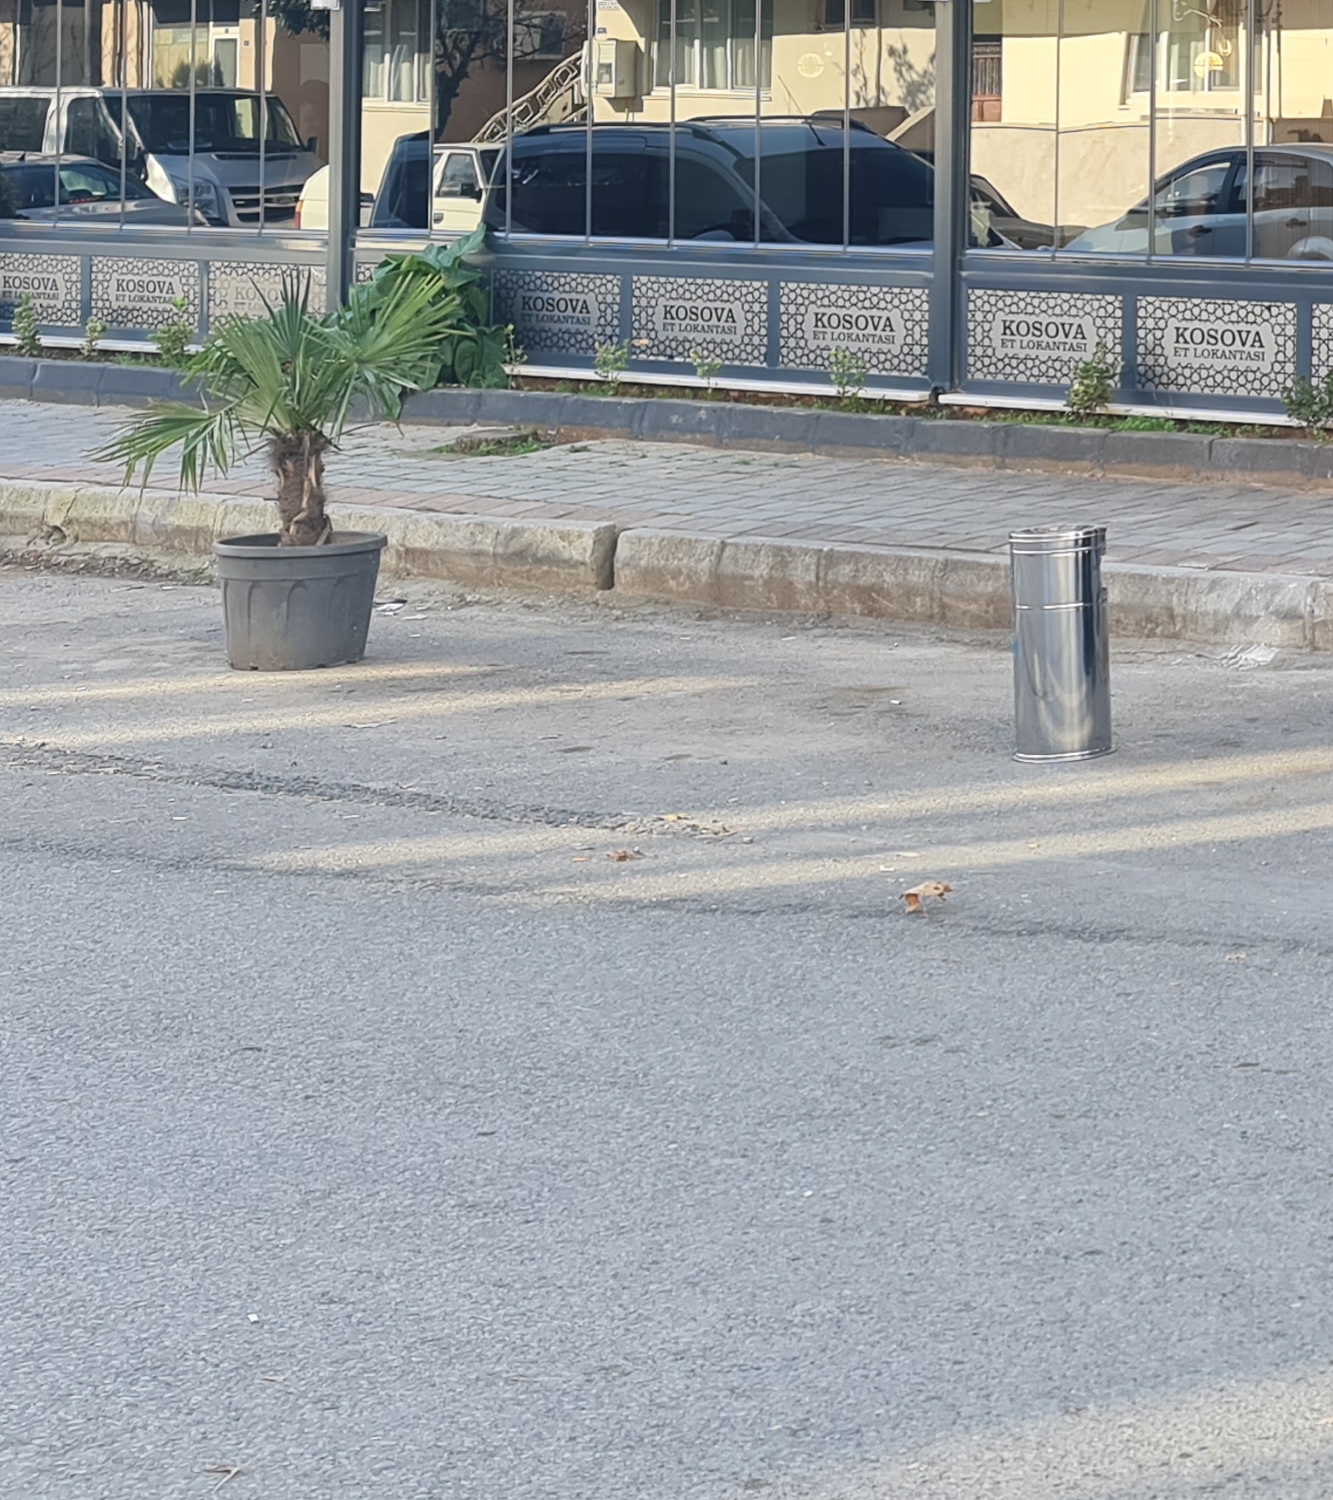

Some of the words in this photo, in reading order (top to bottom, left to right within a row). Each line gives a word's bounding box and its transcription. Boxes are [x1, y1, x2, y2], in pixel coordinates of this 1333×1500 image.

[3, 275, 59, 291] KOSOVA
[116, 278, 176, 294] KOSOVA
[520, 295, 591, 315] KOSOVA
[520, 312, 537, 322] ET
[539, 314, 592, 327] LOKANTASI
[662, 303, 738, 324] KOSOVA
[662, 323, 678, 333] ET
[680, 323, 738, 336] LOKANTASI
[813, 311, 895, 333] KOSOVA
[1000, 319, 1088, 341] KOSOVA
[812, 330, 829, 341] ET
[831, 331, 896, 345] LOKANTASI
[1173, 326, 1265, 348] KOSOVA
[1000, 338, 1017, 350] ET
[1019, 339, 1088, 353] LOKANTASI
[1173, 346, 1191, 358] ET
[1193, 348, 1266, 363] LOKANTASI
